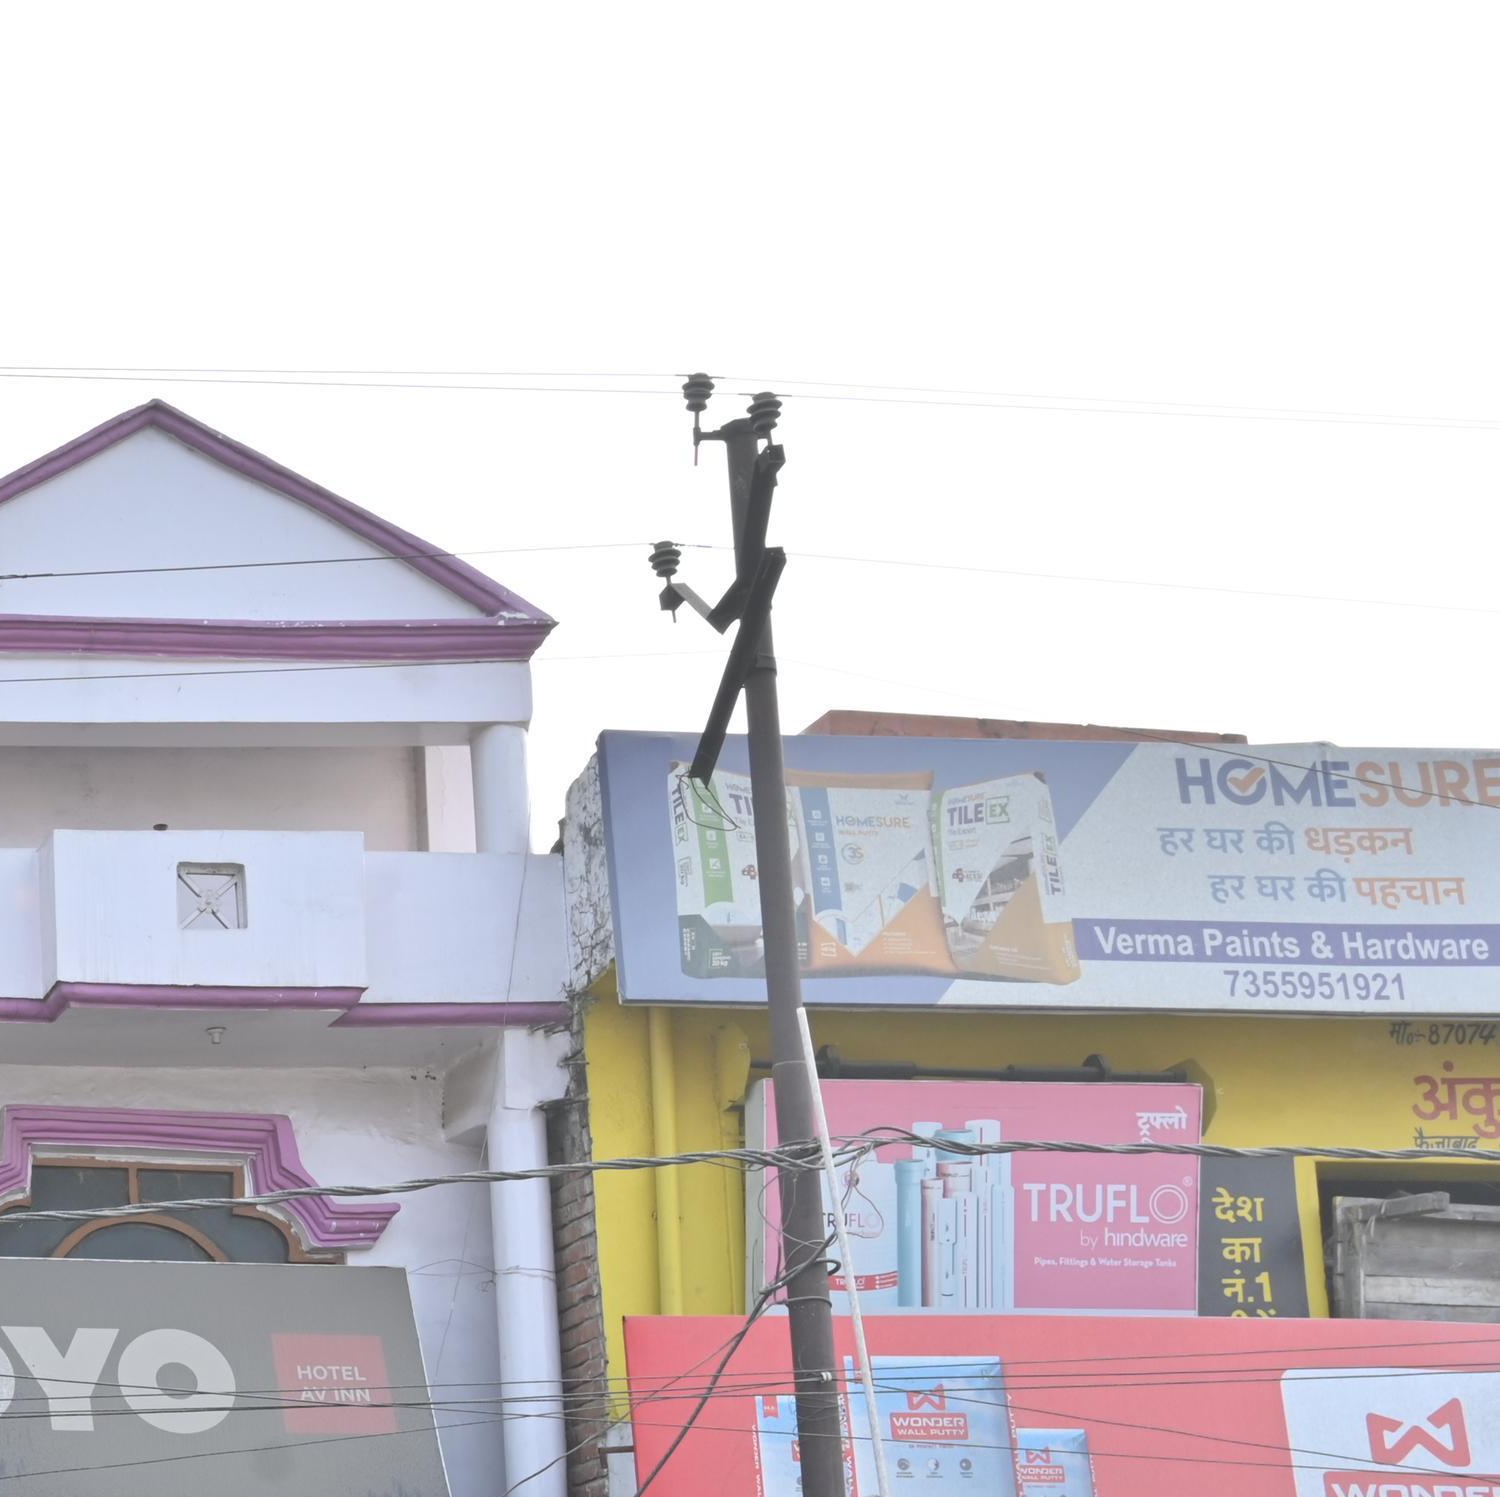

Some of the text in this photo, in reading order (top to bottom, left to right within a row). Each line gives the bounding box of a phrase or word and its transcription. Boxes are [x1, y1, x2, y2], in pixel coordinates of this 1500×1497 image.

[1175, 757, 1500, 809] HOMESURE
[1157, 828, 1194, 856] हर
[1204, 828, 1243, 854] घर
[1254, 821, 1294, 855] की
[1208, 868, 1466, 909] हर घर की पहचान
[1094, 926, 1489, 960] Verma Paints & Hardware
[1223, 969, 1407, 1001] 7355951921
[1023, 1183, 1189, 1225] TRUFLO
[1212, 1187, 1264, 1223] देश
[1079, 1228, 1188, 1250] by hindware
[1222, 1237, 1262, 1263] का
[297, 1365, 367, 1381] HOTEL
[892, 1416, 965, 1428] WONDER
[897, 1428, 965, 1437] WALL PUTTY
